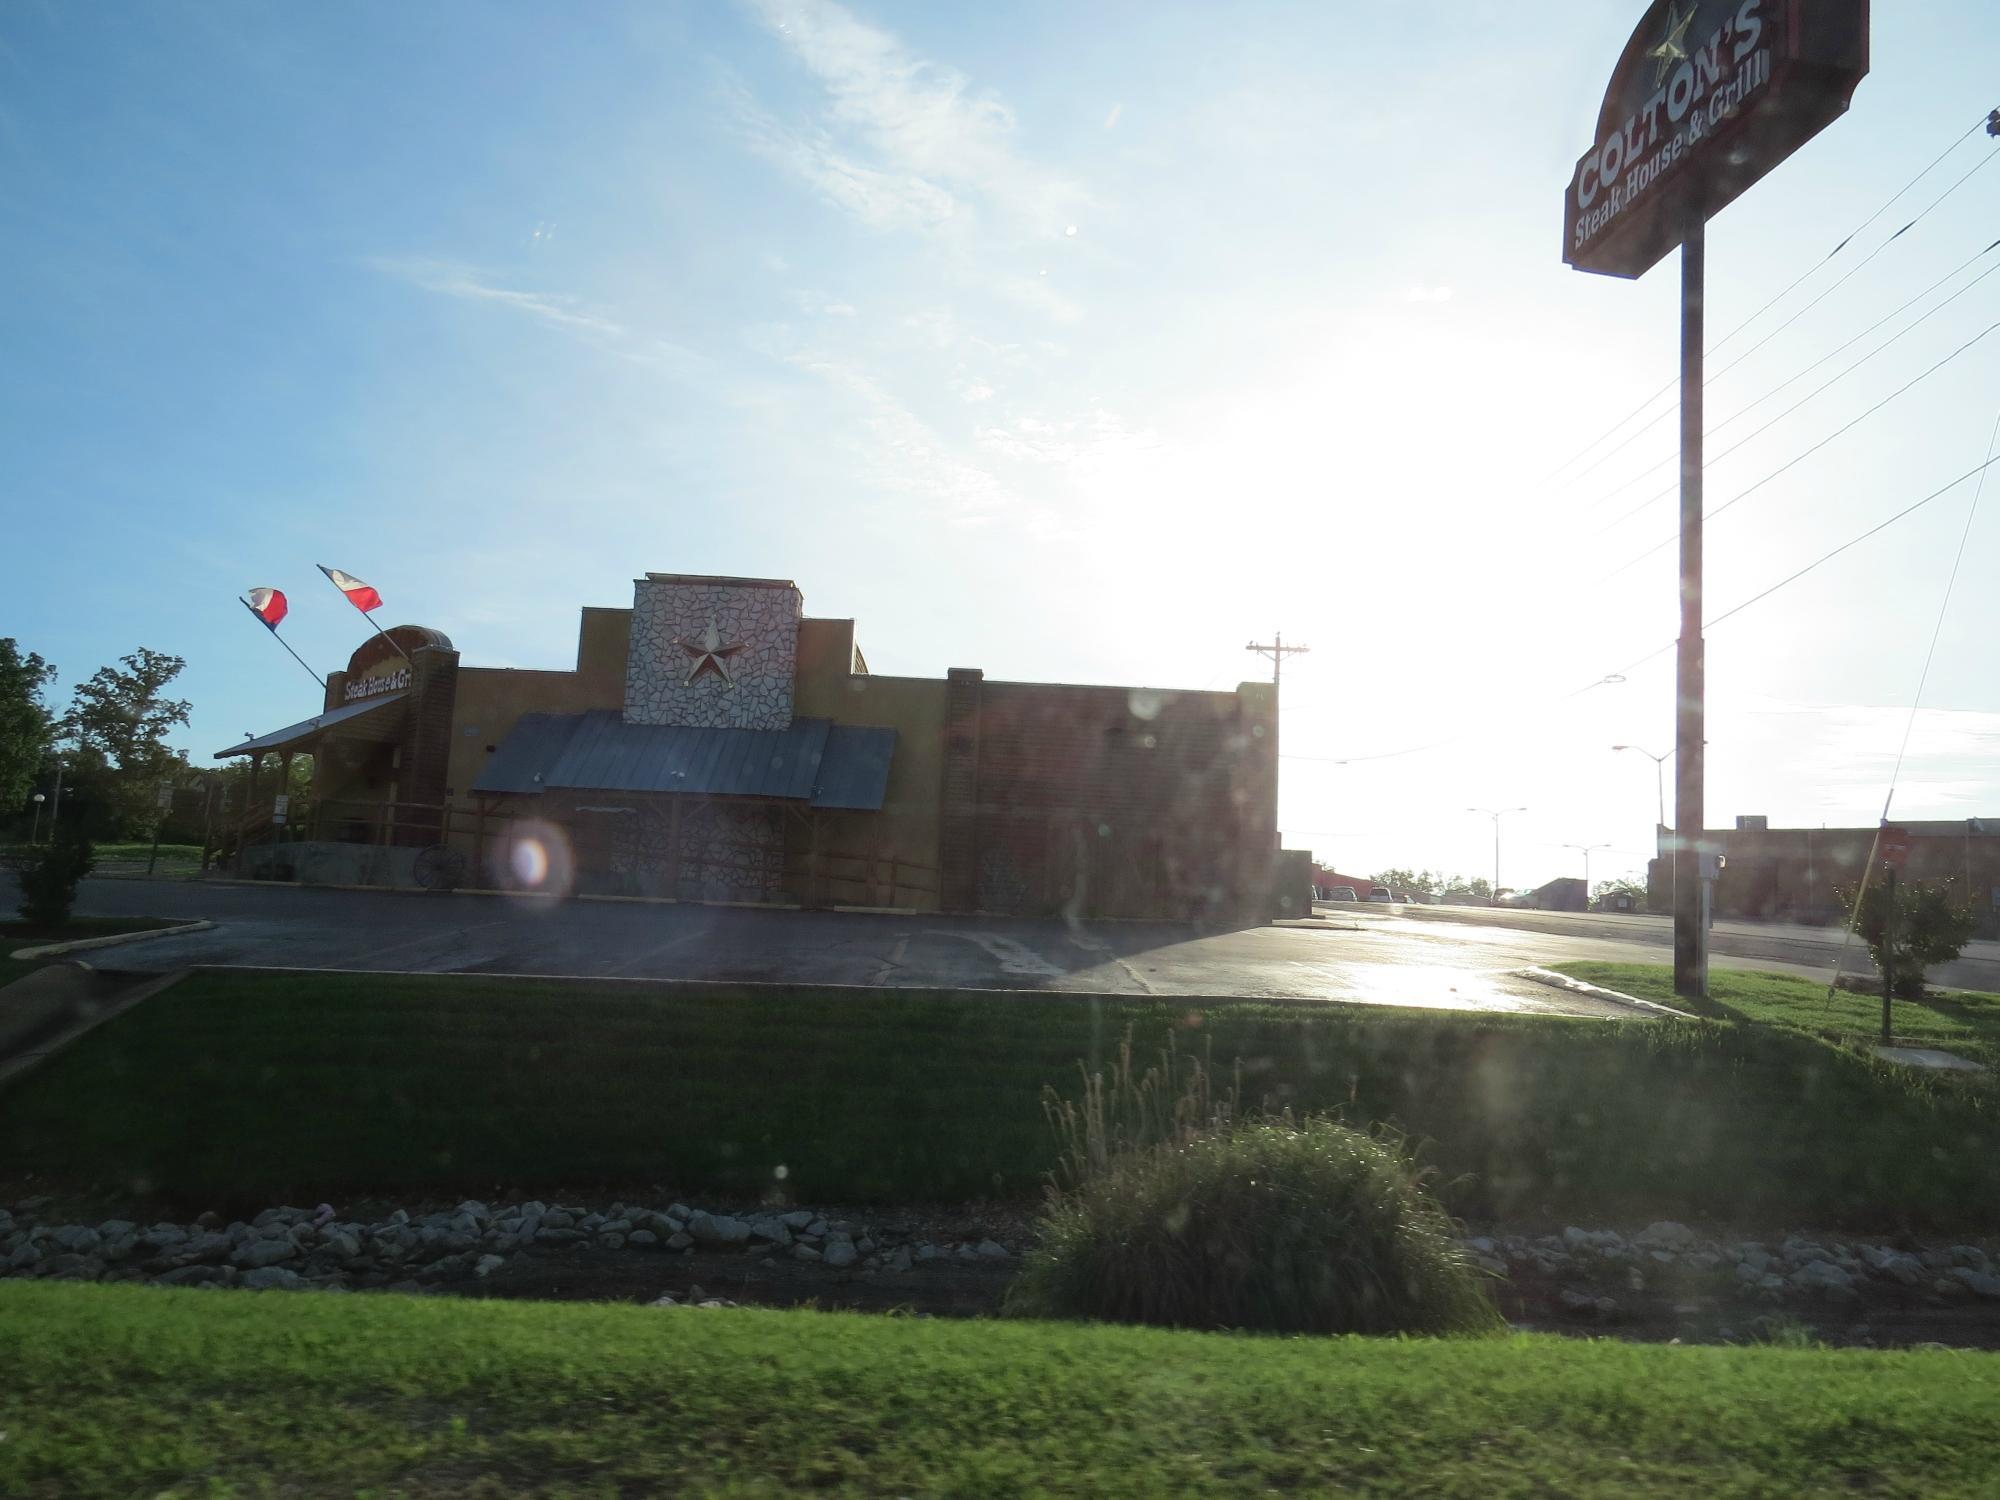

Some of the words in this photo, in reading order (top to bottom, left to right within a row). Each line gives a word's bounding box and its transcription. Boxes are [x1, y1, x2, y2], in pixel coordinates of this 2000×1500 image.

[1575, 187, 1622, 250] Steak
[1626, 132, 1683, 204] House
[1688, 110, 1703, 146] &
[1708, 49, 1770, 126] Grill
[1577, 0, 1762, 209] COLTON'S
[344, 680, 368, 700] Steak
[368, 675, 390, 695] House
[390, 672, 398, 690] &
